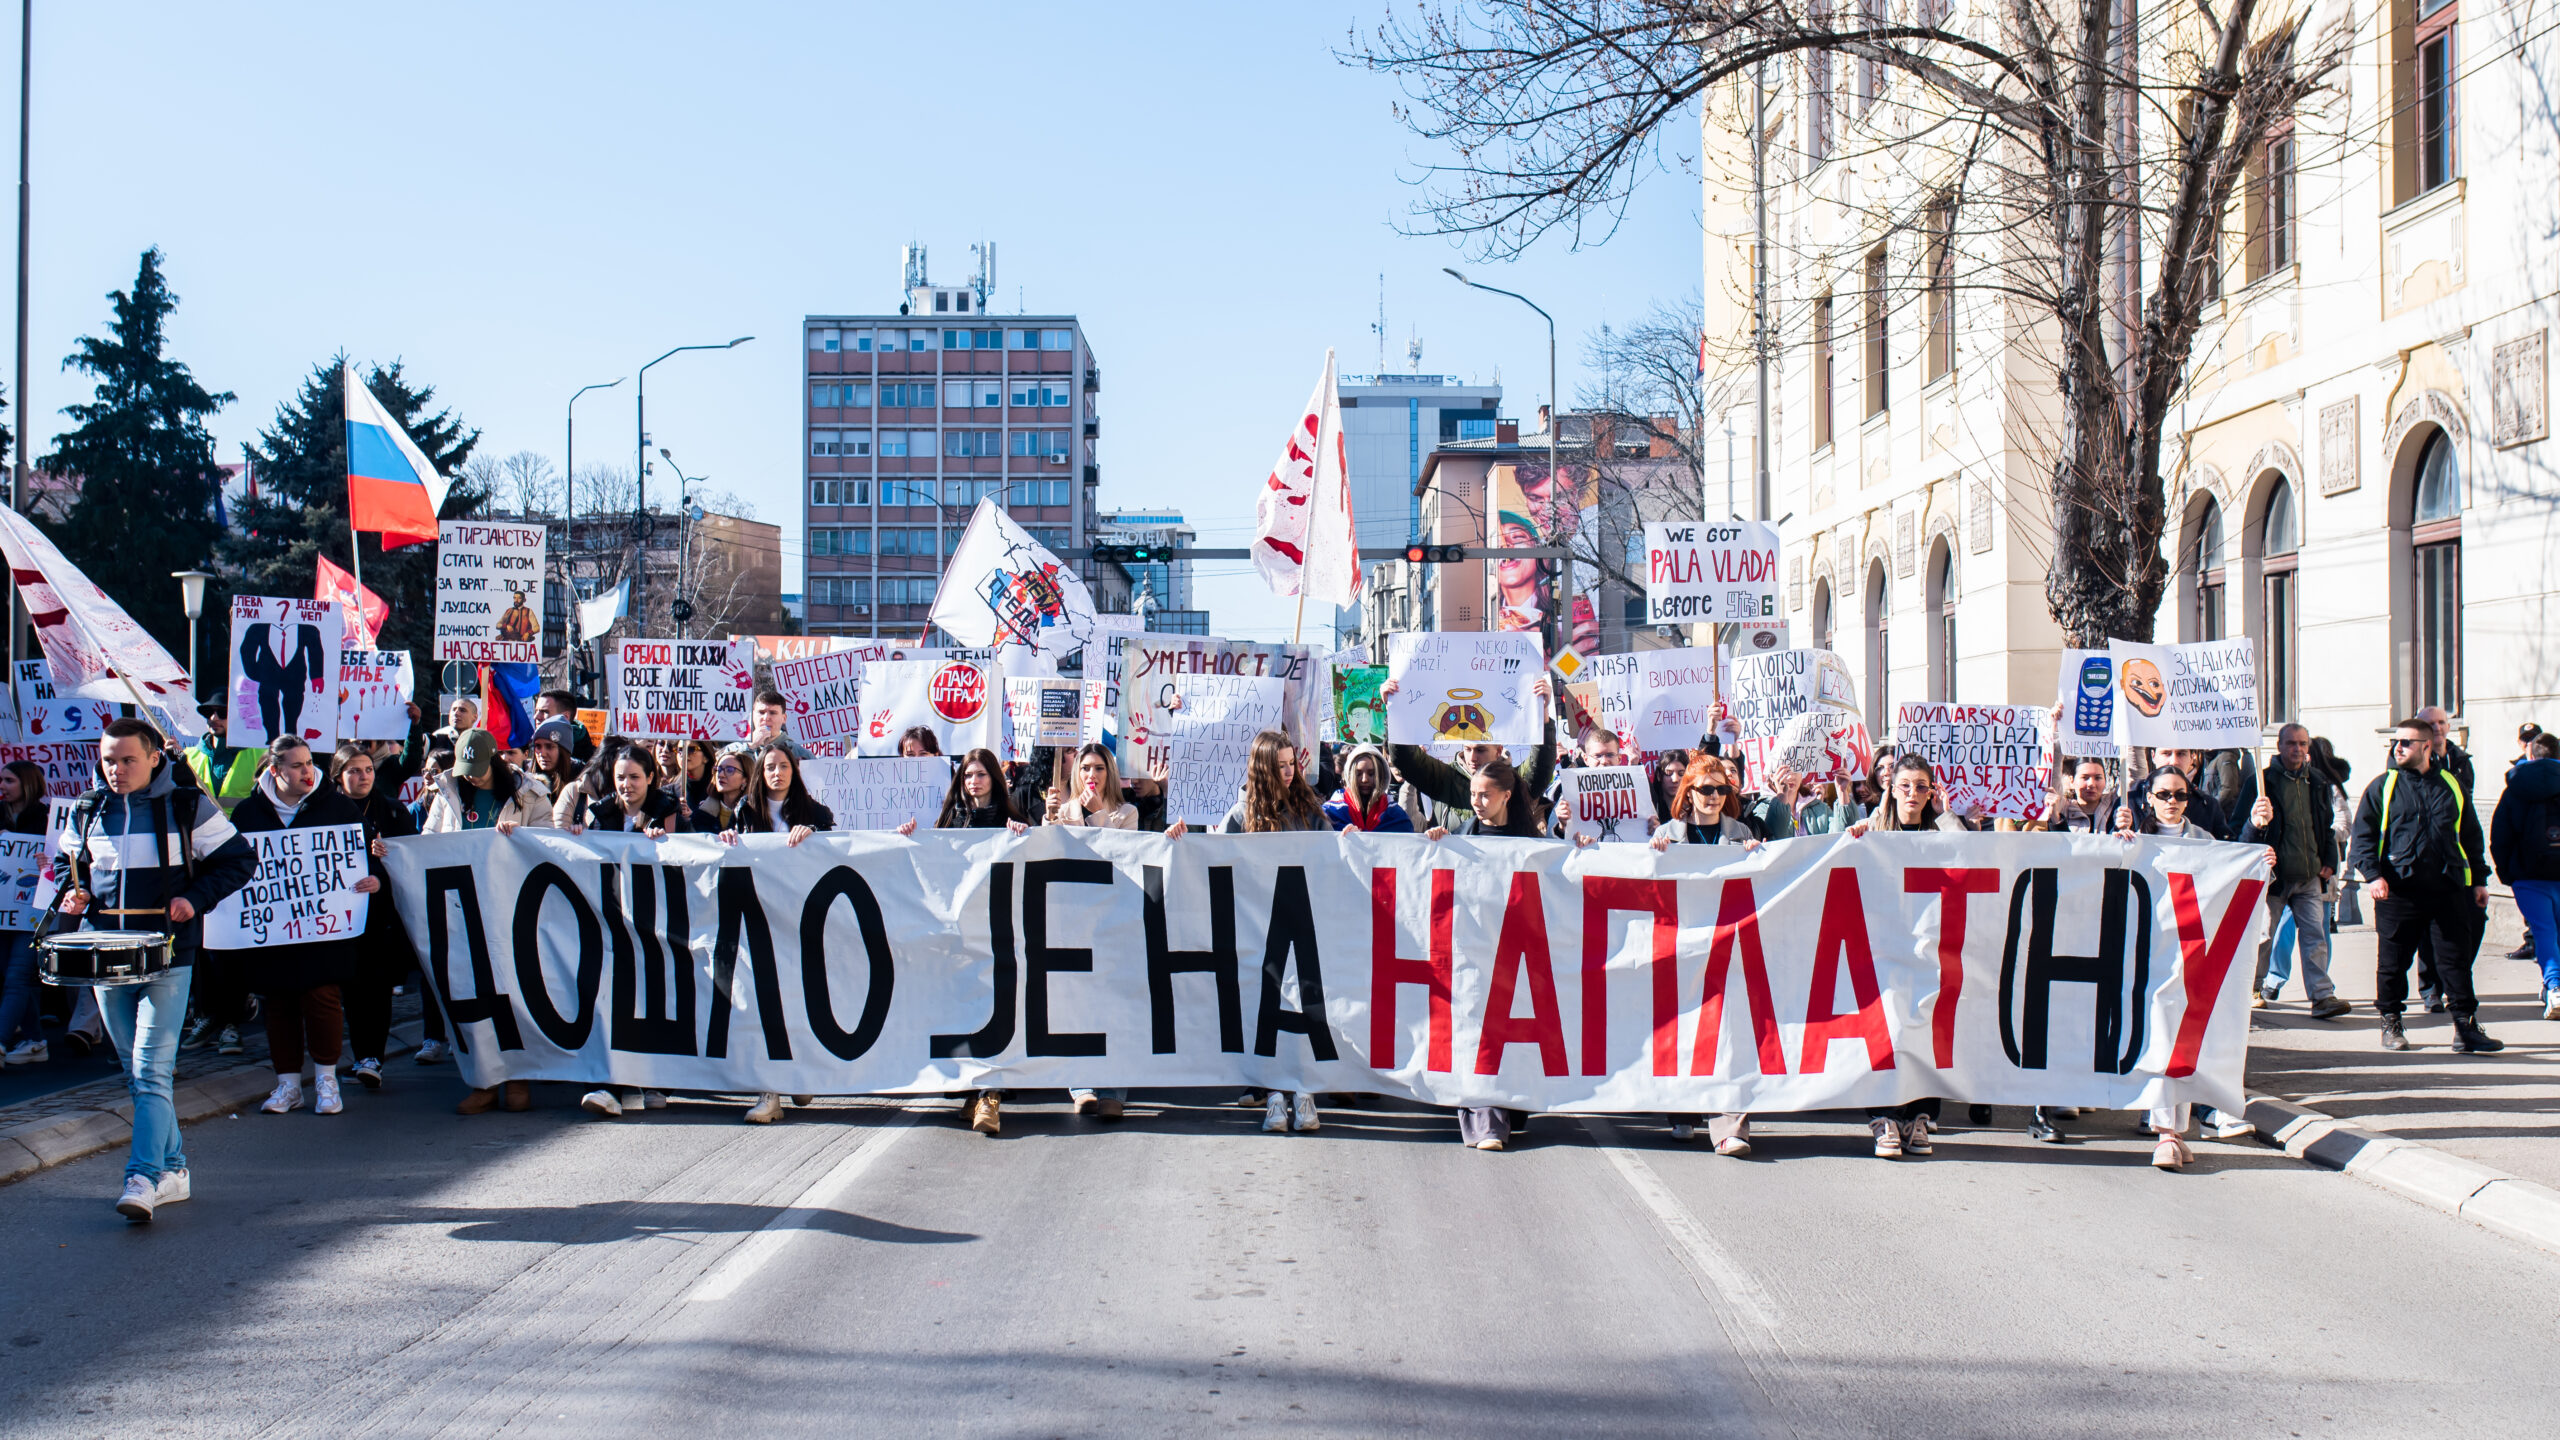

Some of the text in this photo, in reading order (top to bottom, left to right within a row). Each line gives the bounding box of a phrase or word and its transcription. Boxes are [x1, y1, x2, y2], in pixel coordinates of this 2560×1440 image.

[456, 526, 542, 547] ТИРЈАНСТВУ
[1665, 528, 1742, 542] WE GOT
[443, 553, 534, 570] СТАТИ НОГОМ
[1651, 548, 1776, 583] PALA VLADA
[438, 577, 452, 590] ЗА
[504, 579, 518, 593] ТО
[522, 580, 538, 593] ЈЕ
[234, 596, 263, 608] ЛЕВА
[296, 599, 330, 613] ДЕСНИ
[236, 607, 260, 619] РУКА
[441, 601, 491, 614] ЉУДСКА
[989, 578, 1040, 638] ПРЕДА
[1652, 595, 1712, 619] before
[1742, 621, 1787, 629] HOTEL
[443, 641, 539, 662] НАЈСВЕТИЈА
[677, 645, 727, 666] ПОКАЖИ
[1475, 640, 1507, 655] NEKO
[341, 650, 404, 667] ЕБЕ СВЕ
[1136, 649, 1269, 678] УМЕТНОСТ
[1275, 655, 1308, 680] ЈЕ
[1593, 655, 1639, 677] NAŠA
[2174, 648, 2254, 676] ЗНАШ КАО
[20, 663, 43, 682] НЕ
[624, 667, 703, 689] СВОЈЕ ЛИЦЕ
[35, 682, 57, 700] НА
[933, 687, 986, 703] ШТРАЈК
[2166, 673, 2256, 697] ИСПУНИО ЗАХТЕВИ
[625, 690, 746, 712] УЗ СТУДЕНТЕ САДА
[1181, 699, 1281, 723] ЖИВИМ У
[1767, 695, 1807, 718] IMAMO
[2170, 697, 2255, 714] А УСТВАРИ НИЈЕ
[623, 713, 640, 733] НА
[798, 706, 859, 740] ПОСТОЈ
[1899, 705, 2014, 726] NOVINARSKO
[2172, 716, 2259, 732] ИСПУНИО ЗАХТЕВИ
[1173, 720, 1262, 743] ДРУШТВУ
[1940, 725, 1960, 744] JE
[1963, 725, 1988, 744] OD
[1993, 726, 2037, 744] LAZI
[1172, 740, 1204, 761] ГДЕ
[67, 762, 89, 777] MI
[824, 761, 928, 786] ZAR VAS NIJE
[1971, 765, 1993, 788] SE
[1997, 765, 2052, 790] TRAZI
[1577, 773, 1634, 792] KORUPCIJA
[838, 787, 873, 811] MALO
[881, 786, 944, 810] SRAMOTA
[1579, 789, 1638, 822] UBIJA!
[281, 834, 302, 856] СЕ
[312, 831, 337, 852] ДА
[342, 830, 365, 851] НЕ
[315, 852, 356, 872] ПРЕ
[240, 898, 328, 929] ЕВО НАС
[254, 925, 267, 944] У
[425, 862, 895, 1061] ДОШЛО
[929, 858, 1114, 1060] ЈЕ
[1142, 865, 1339, 1062] НА
